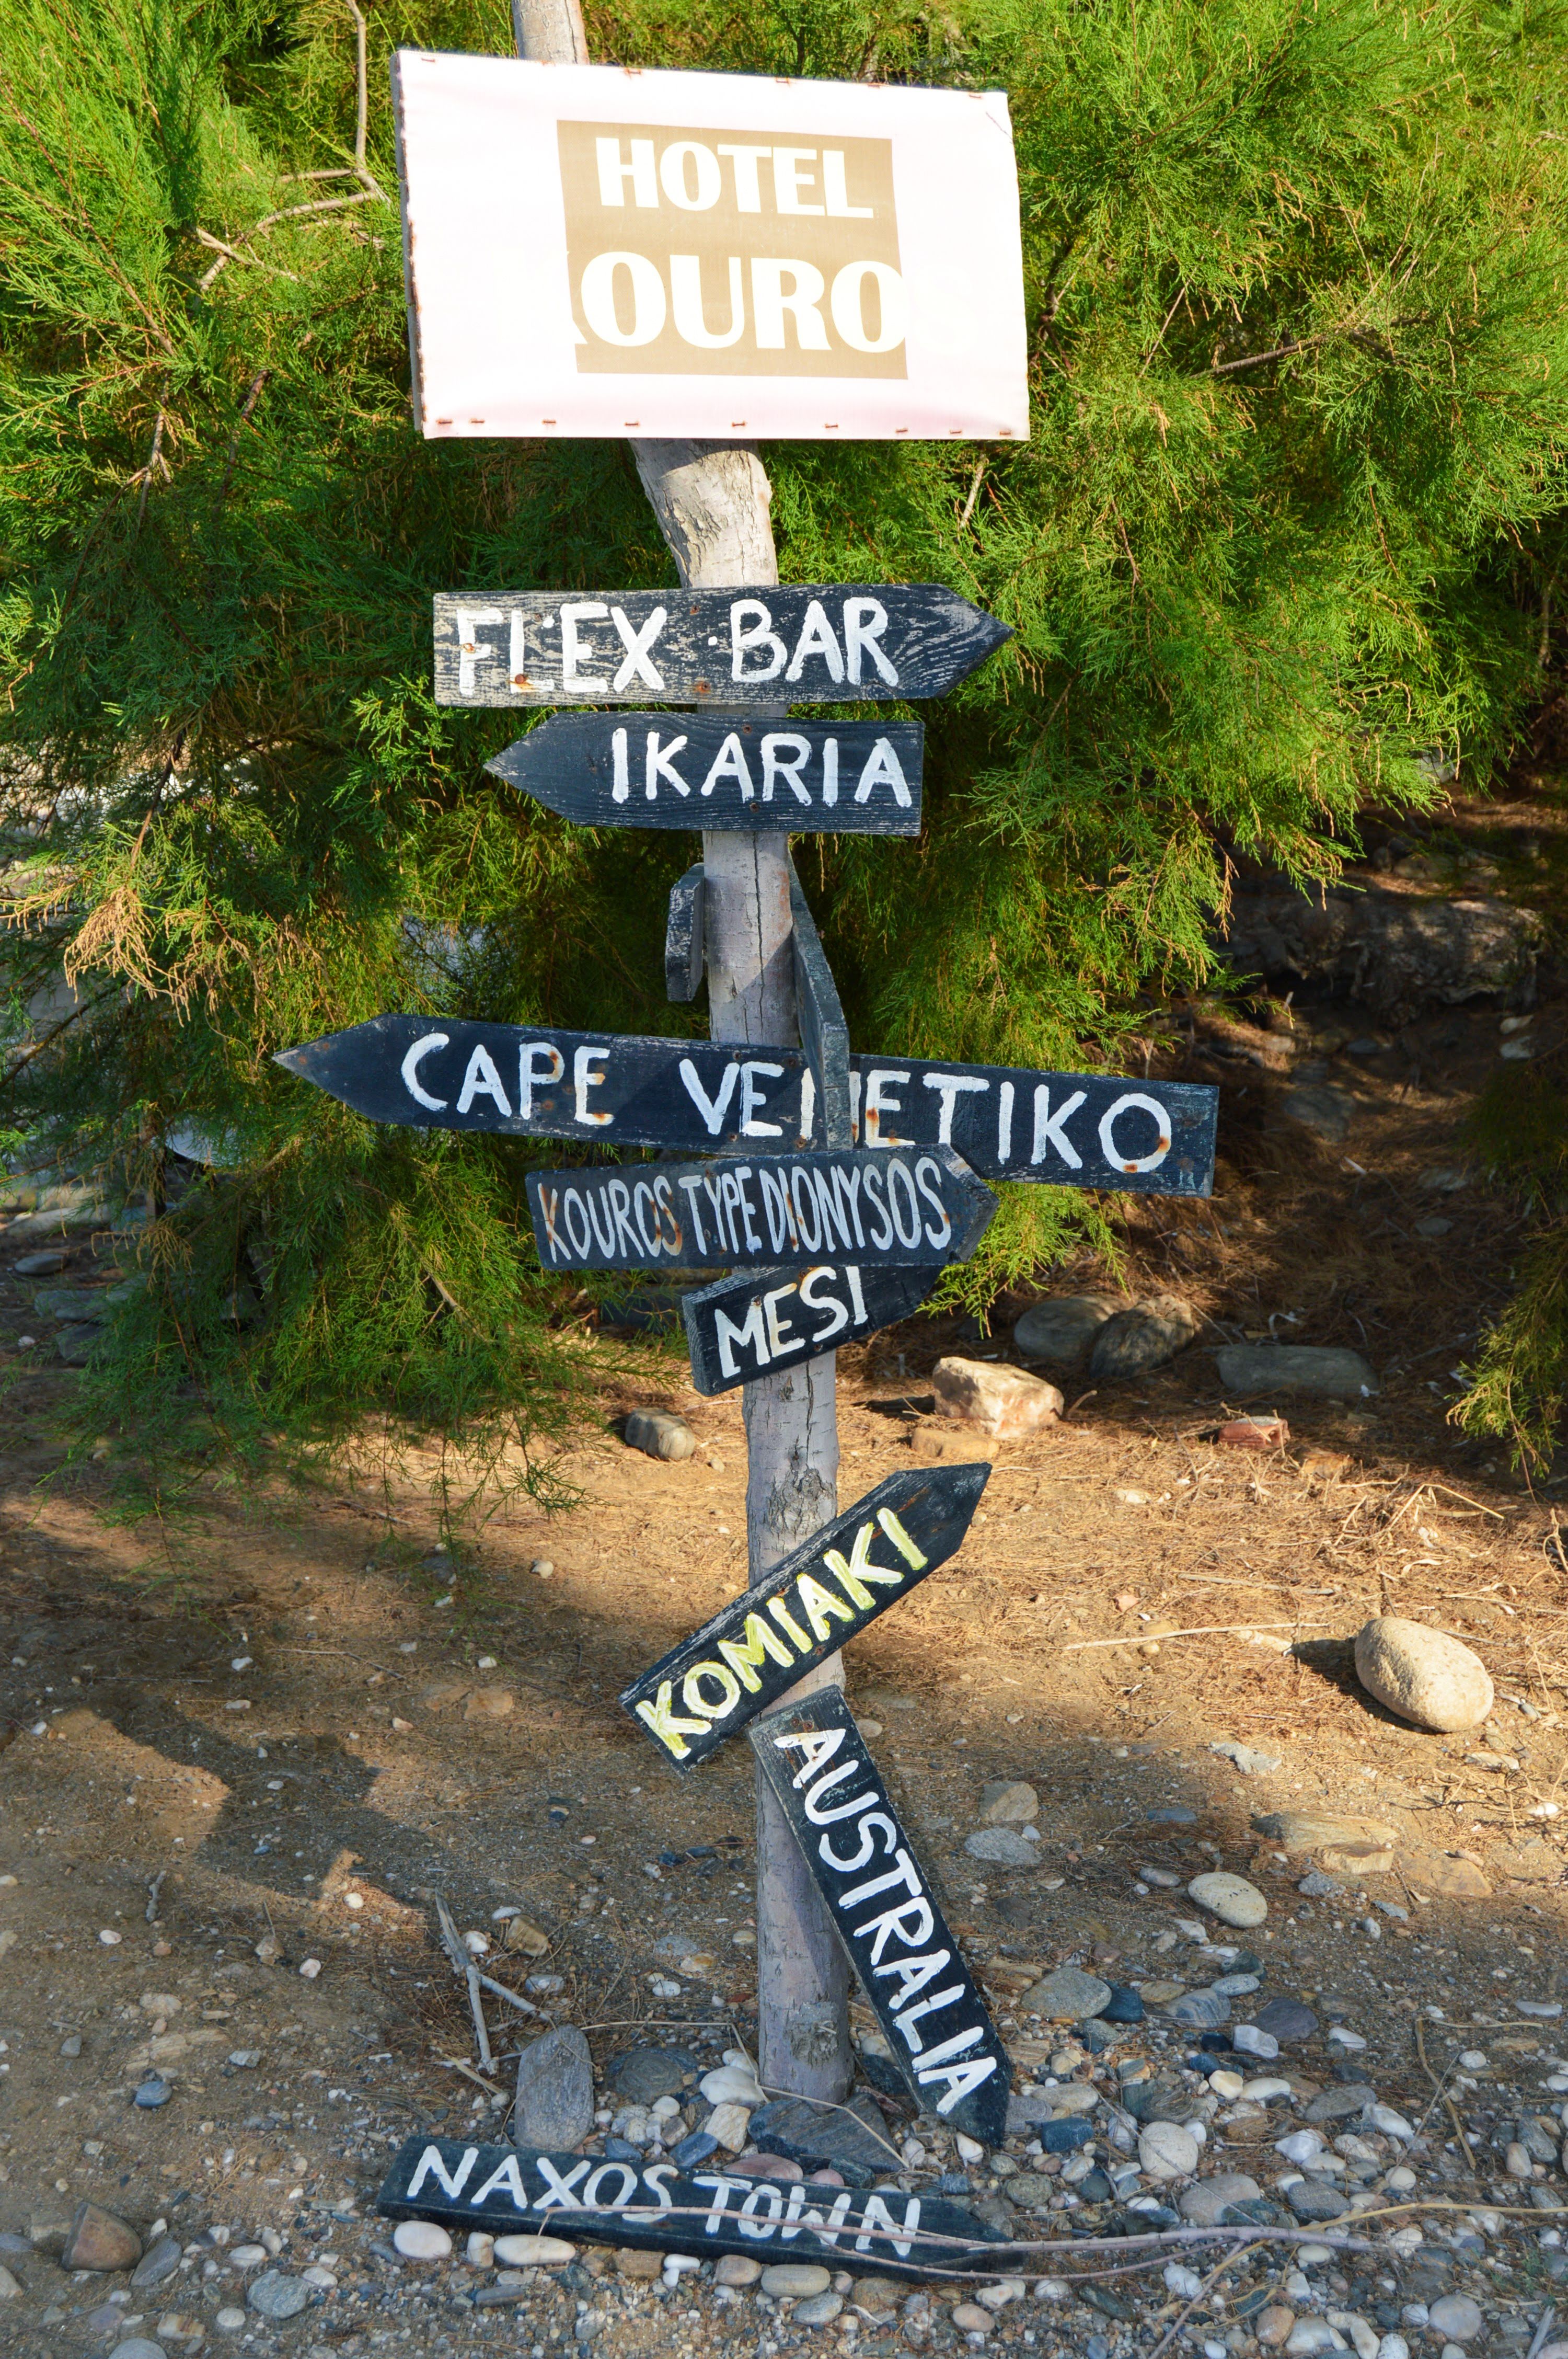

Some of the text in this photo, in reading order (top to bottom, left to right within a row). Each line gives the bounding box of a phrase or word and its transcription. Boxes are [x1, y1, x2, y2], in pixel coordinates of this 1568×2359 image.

[596, 138, 873, 218] HOTEL
[568, 250, 905, 353] OURO
[457, 597, 898, 695] FLEX BAR
[612, 727, 912, 808] IKARIA
[401, 1033, 615, 1126] CAPE
[537, 1156, 951, 1263] KOUROS TYPE DIONYSOS
[714, 1266, 868, 1379] MESI
[635, 1507, 928, 1759] KOMIAKI
[774, 1728, 997, 2115] AUSTRALIA
[407, 2145, 921, 2257] NAXOS TOWN
